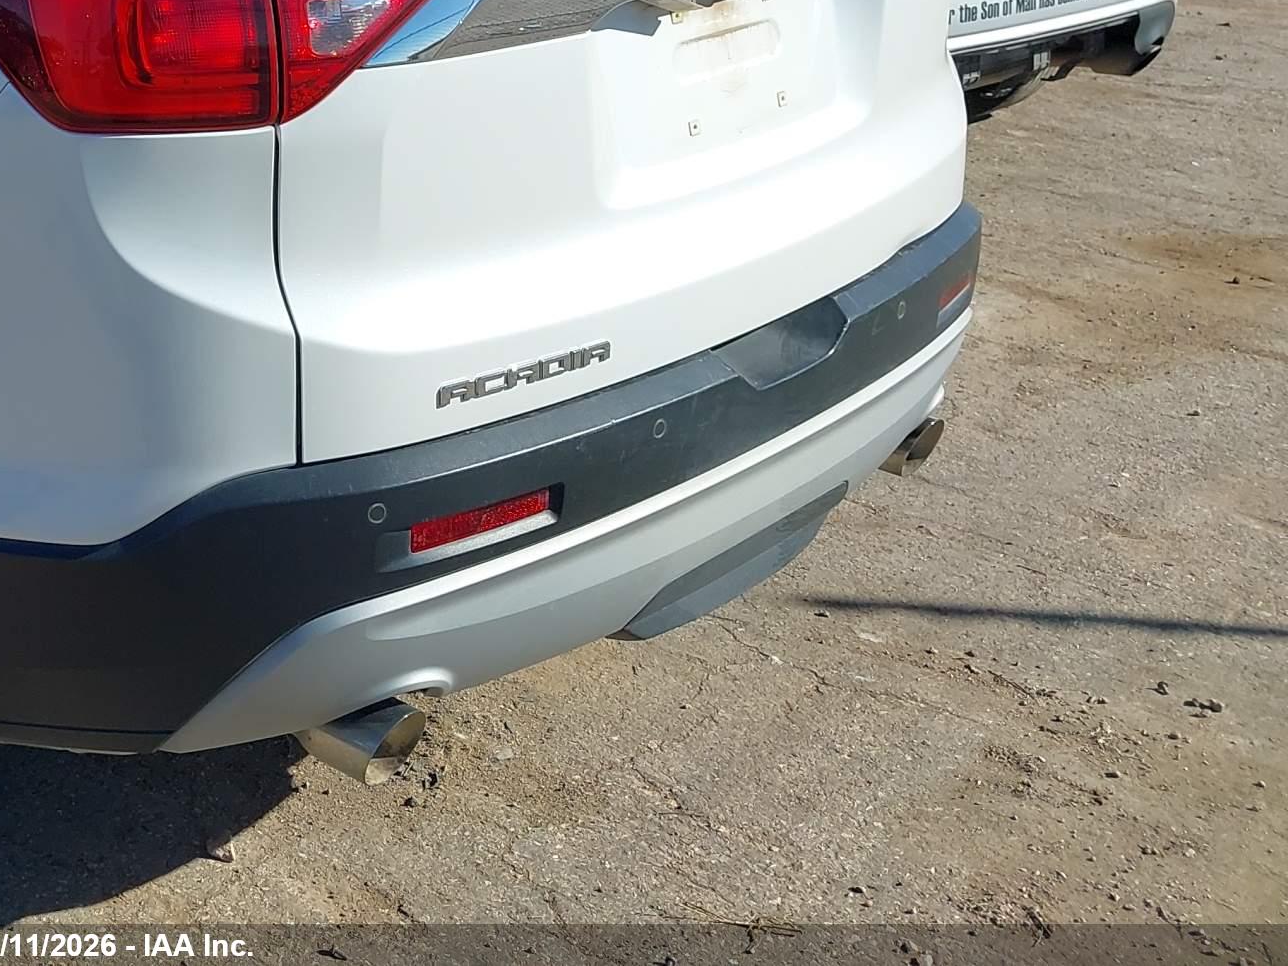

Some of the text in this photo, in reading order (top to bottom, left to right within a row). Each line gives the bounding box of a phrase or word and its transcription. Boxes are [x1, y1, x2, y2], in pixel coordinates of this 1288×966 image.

[959, 3, 978, 23] the
[981, 0, 1000, 20] Son
[435, 339, 611, 409] ACADIA
